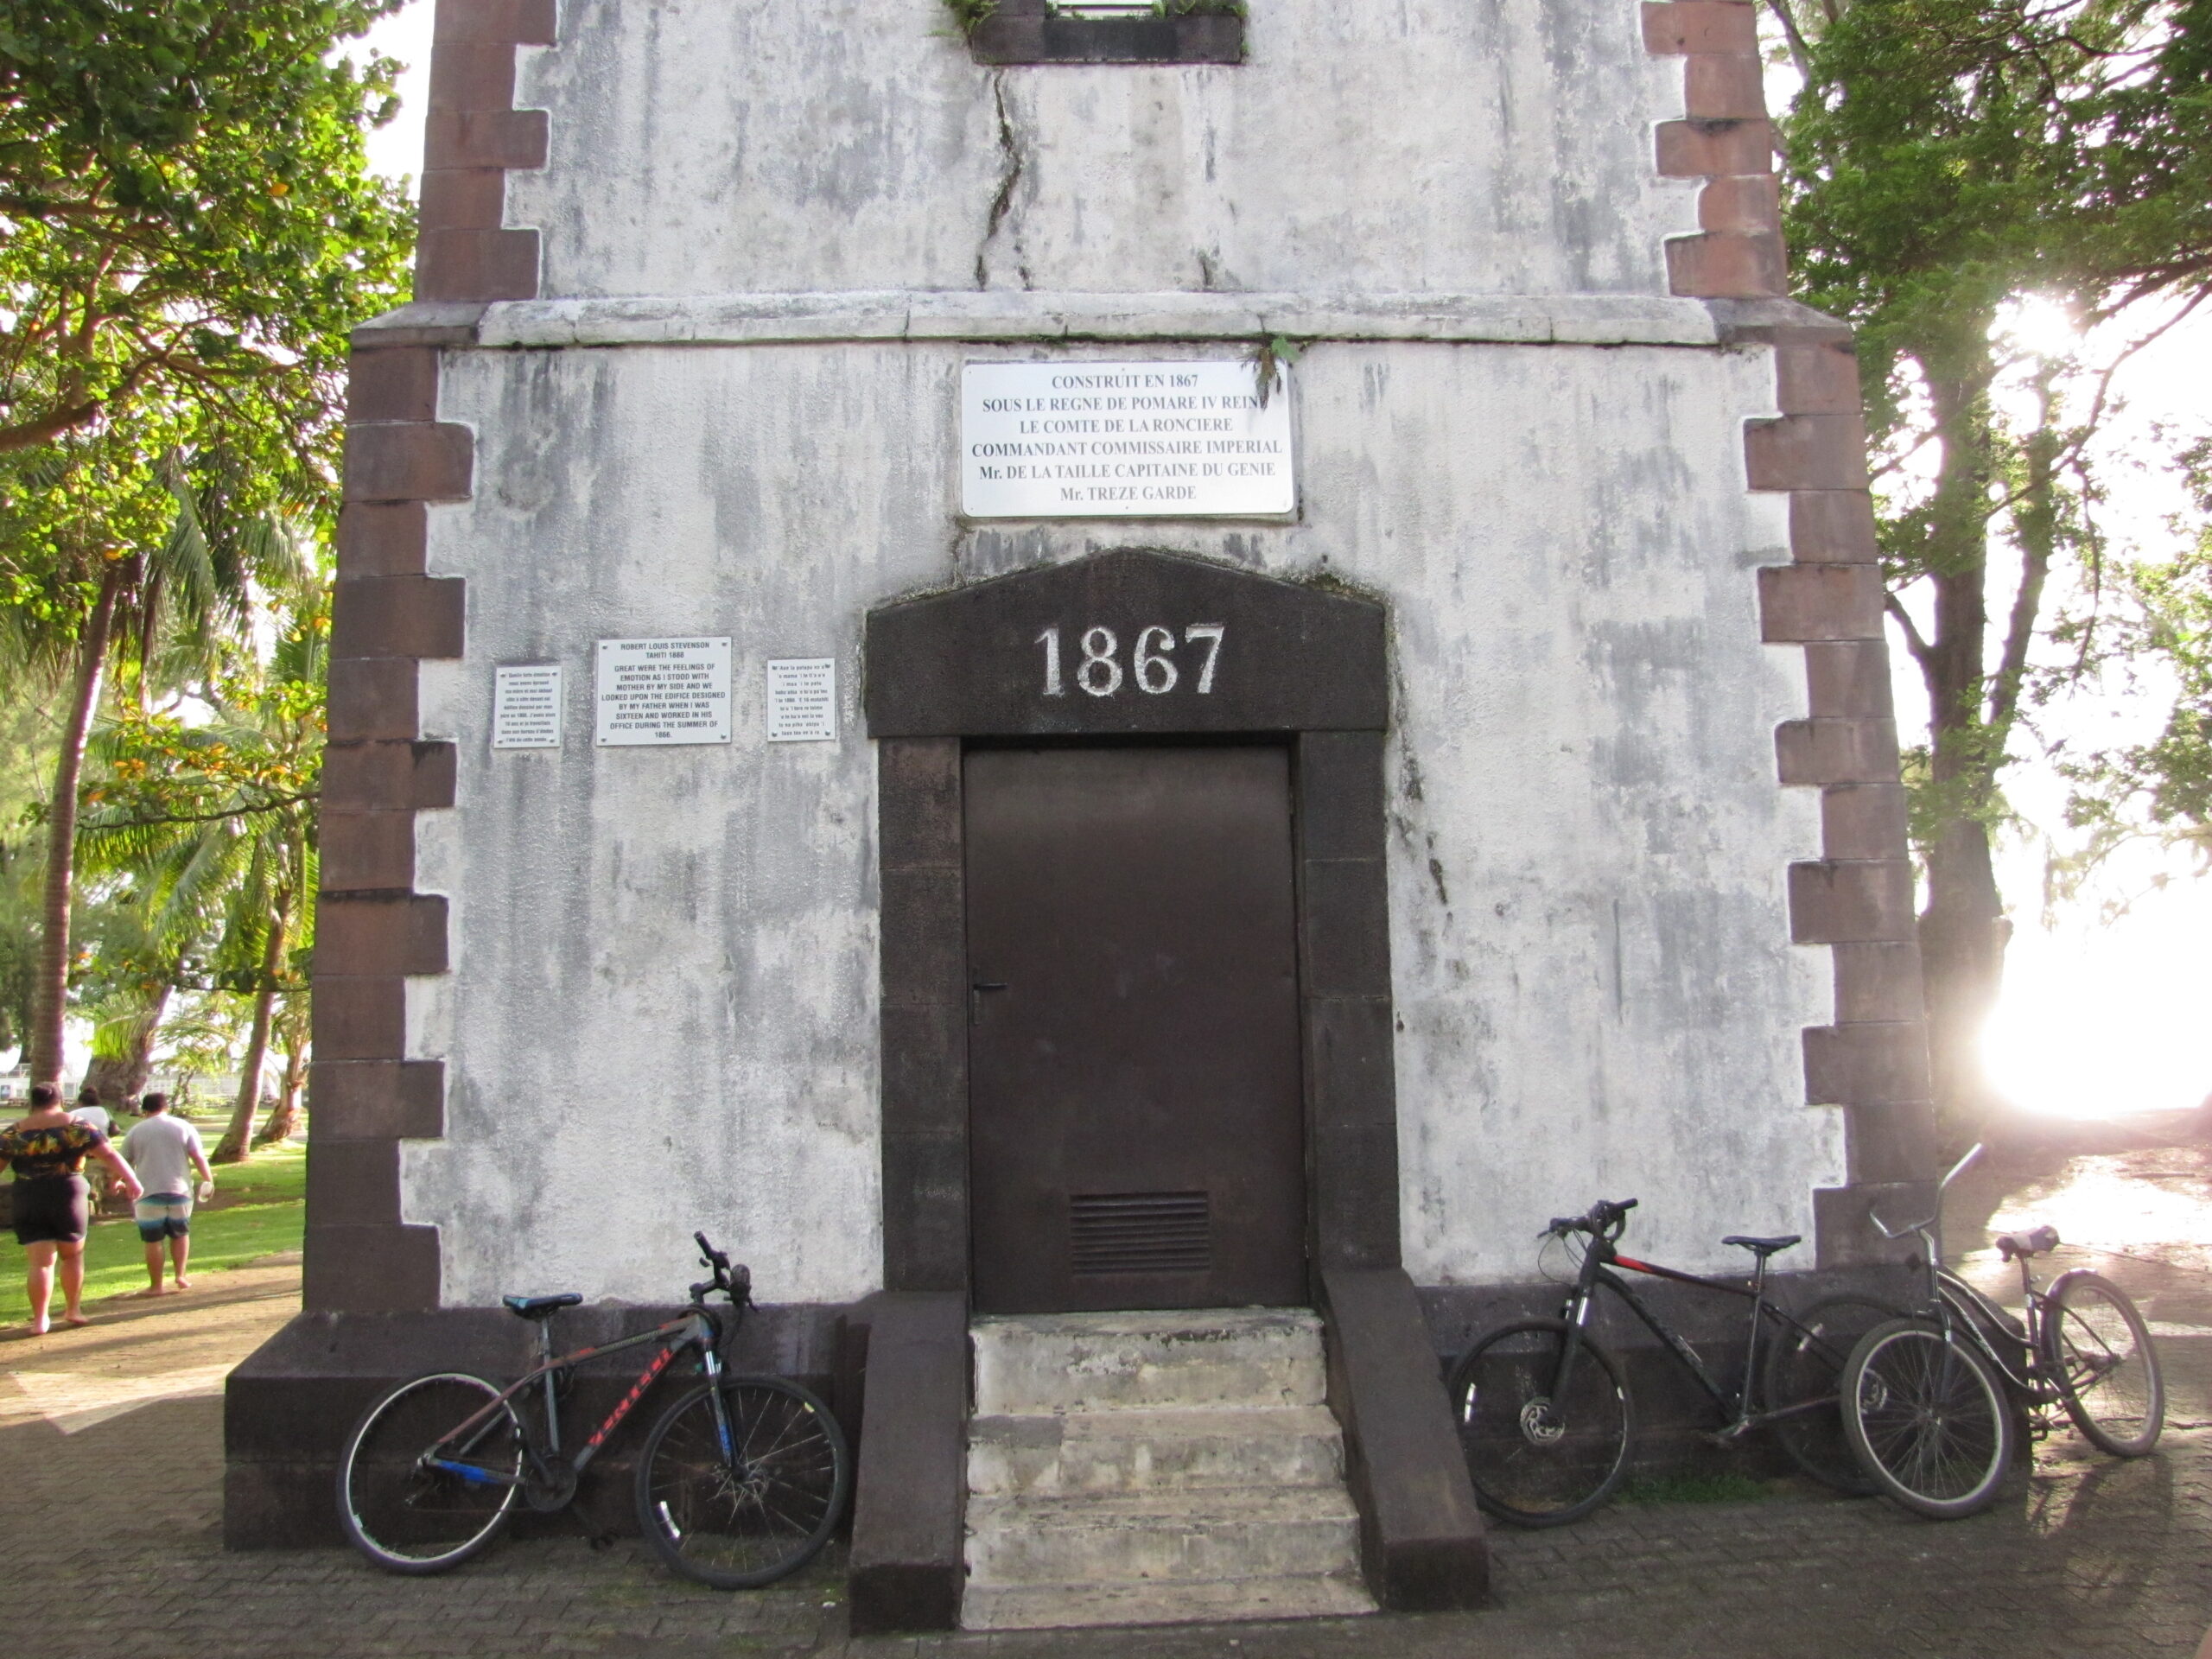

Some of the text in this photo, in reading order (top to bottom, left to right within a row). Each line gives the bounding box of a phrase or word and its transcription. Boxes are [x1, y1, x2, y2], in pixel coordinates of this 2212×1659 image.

[1052, 375, 1198, 388] CONSTRUIT EN 1867
[983, 396, 1268, 411] SOUS LE REGNE DE POMARE IV REIN
[1020, 418, 1232, 433] LE COMTE DE LA RONCIERE
[972, 441, 1281, 457] COMMANDANT COMMISSAIRE IMPERIAL
[981, 463, 1274, 479] Mr. DE LA TAILLE CAPITAINE DU GENIE
[1061, 486, 1196, 500] Mr. TREZE GARDE
[1035, 621, 1225, 696] 1867
